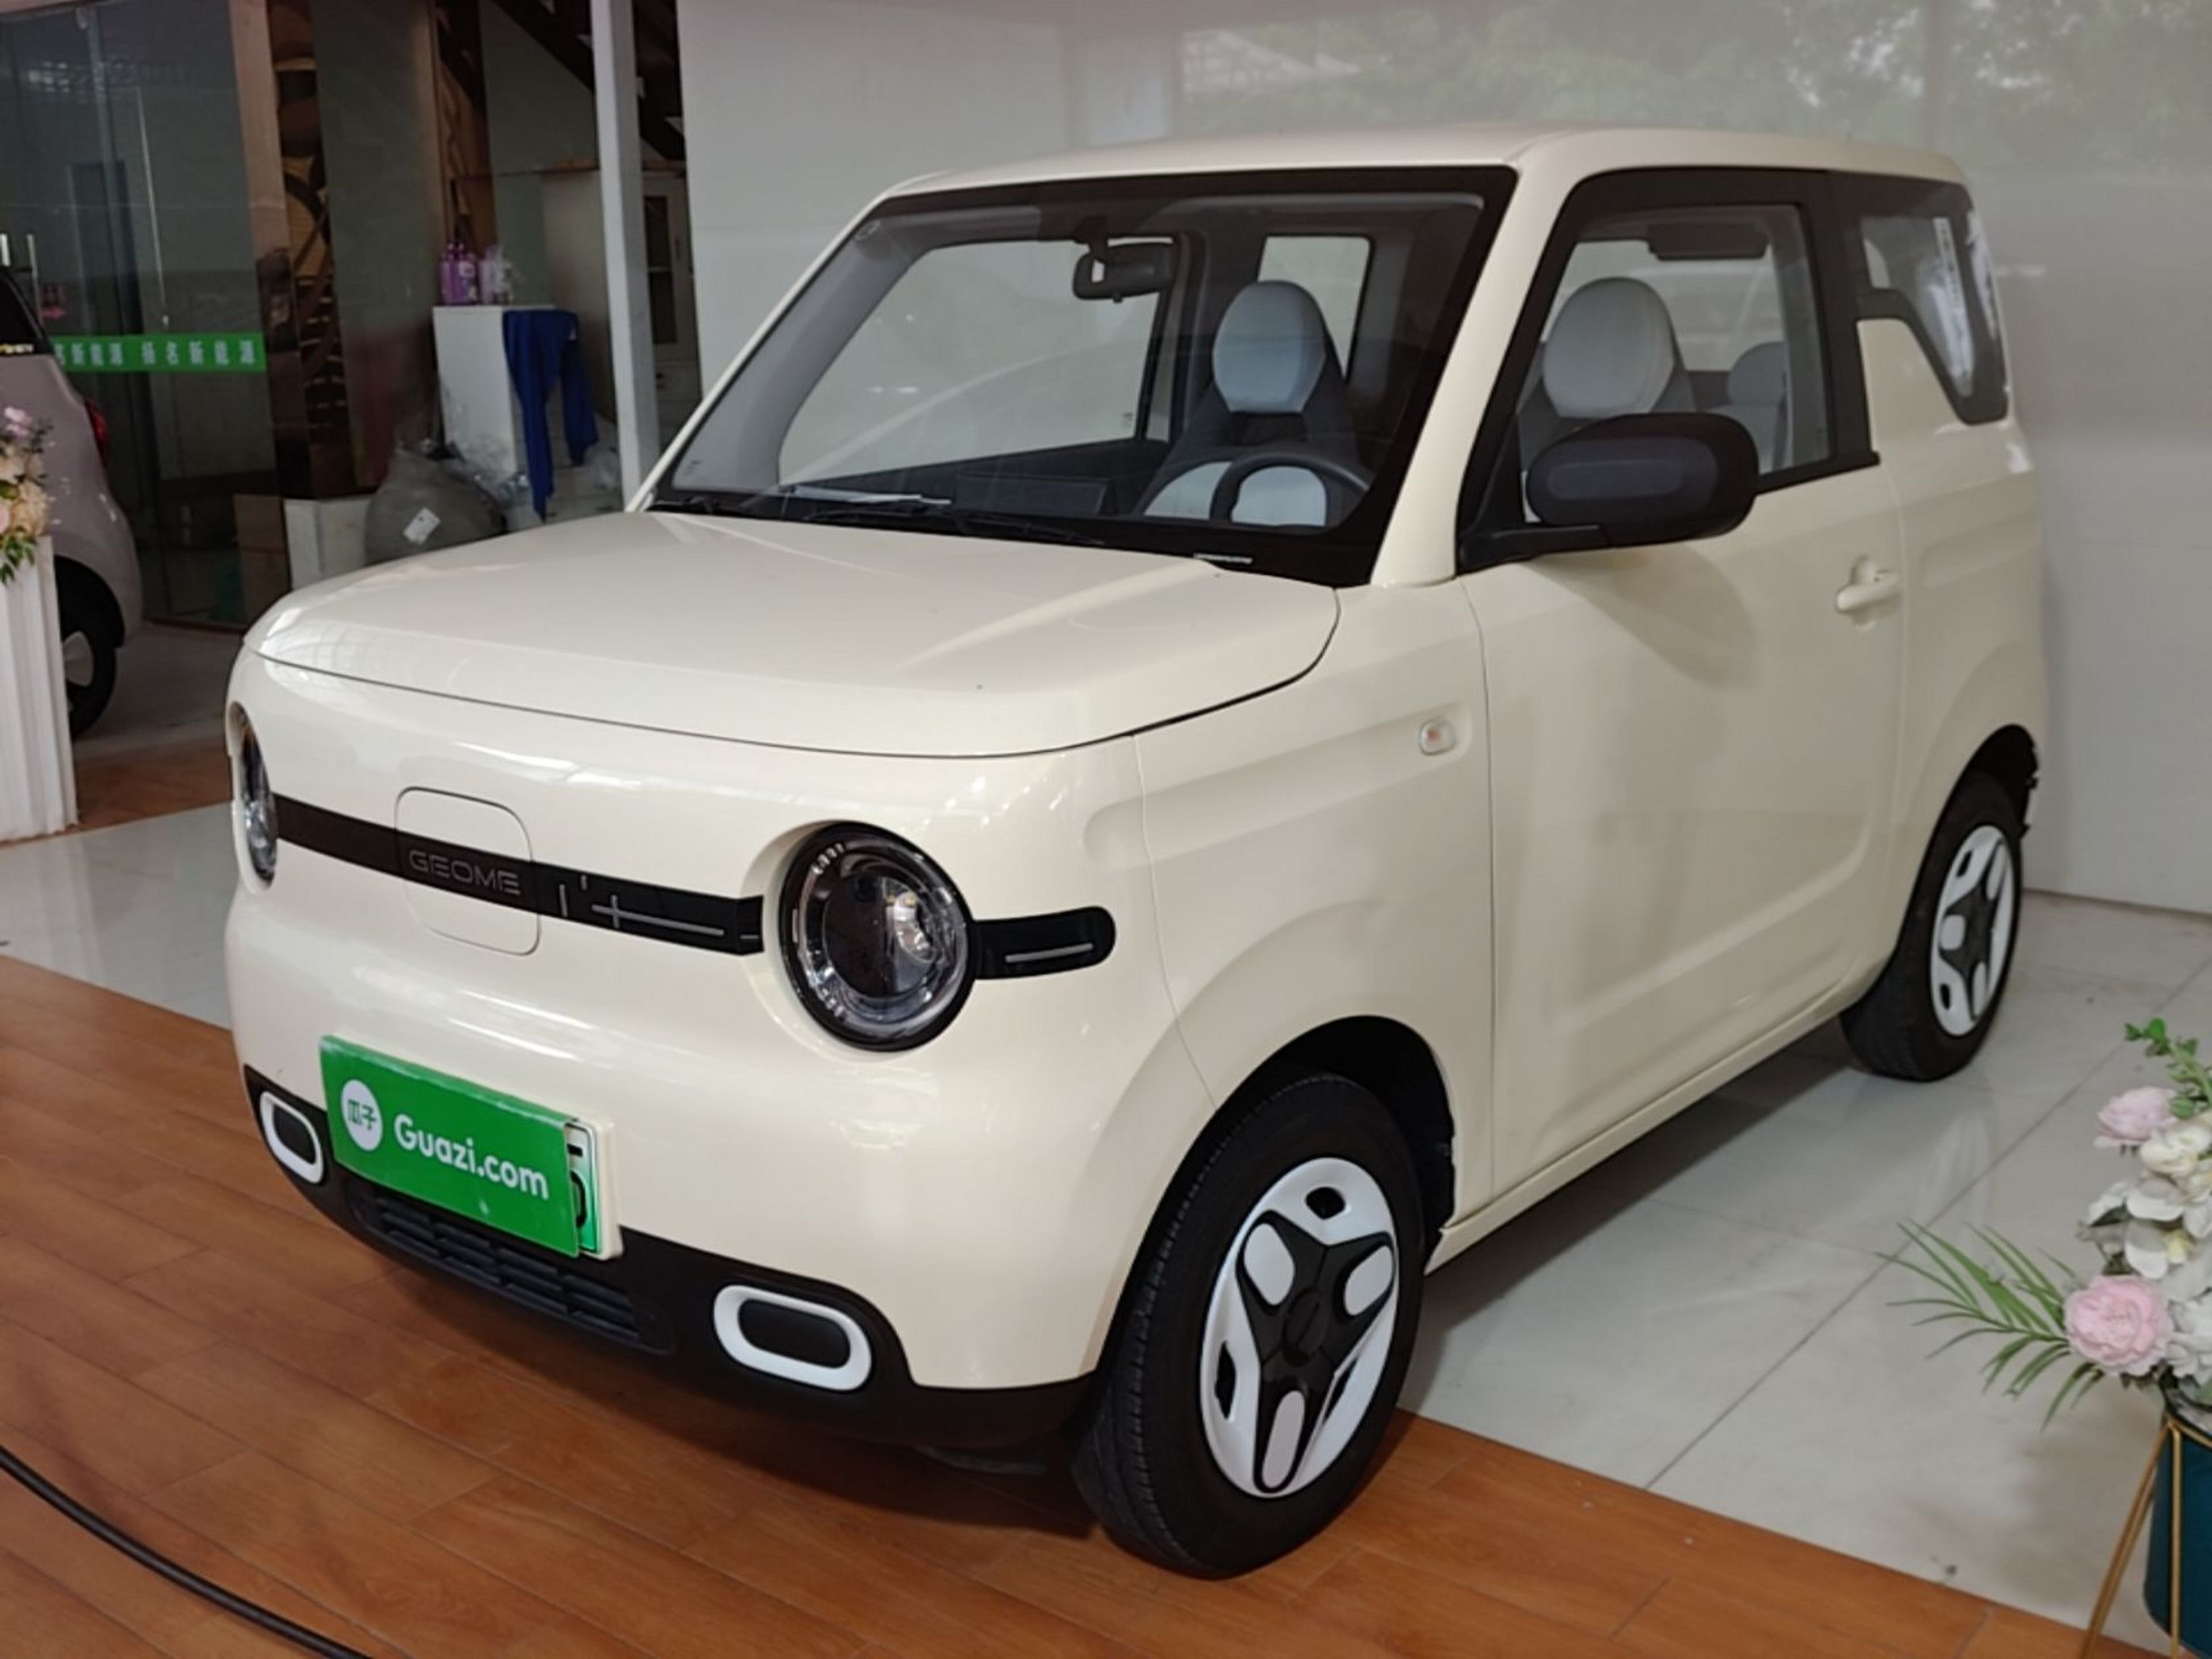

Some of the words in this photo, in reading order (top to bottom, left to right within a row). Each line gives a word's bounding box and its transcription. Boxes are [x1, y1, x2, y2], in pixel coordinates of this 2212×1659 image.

[409, 849, 521, 895] GEOME
[347, 1099, 377, 1131] 瓜子
[393, 1113, 549, 1200] Guazi.com
